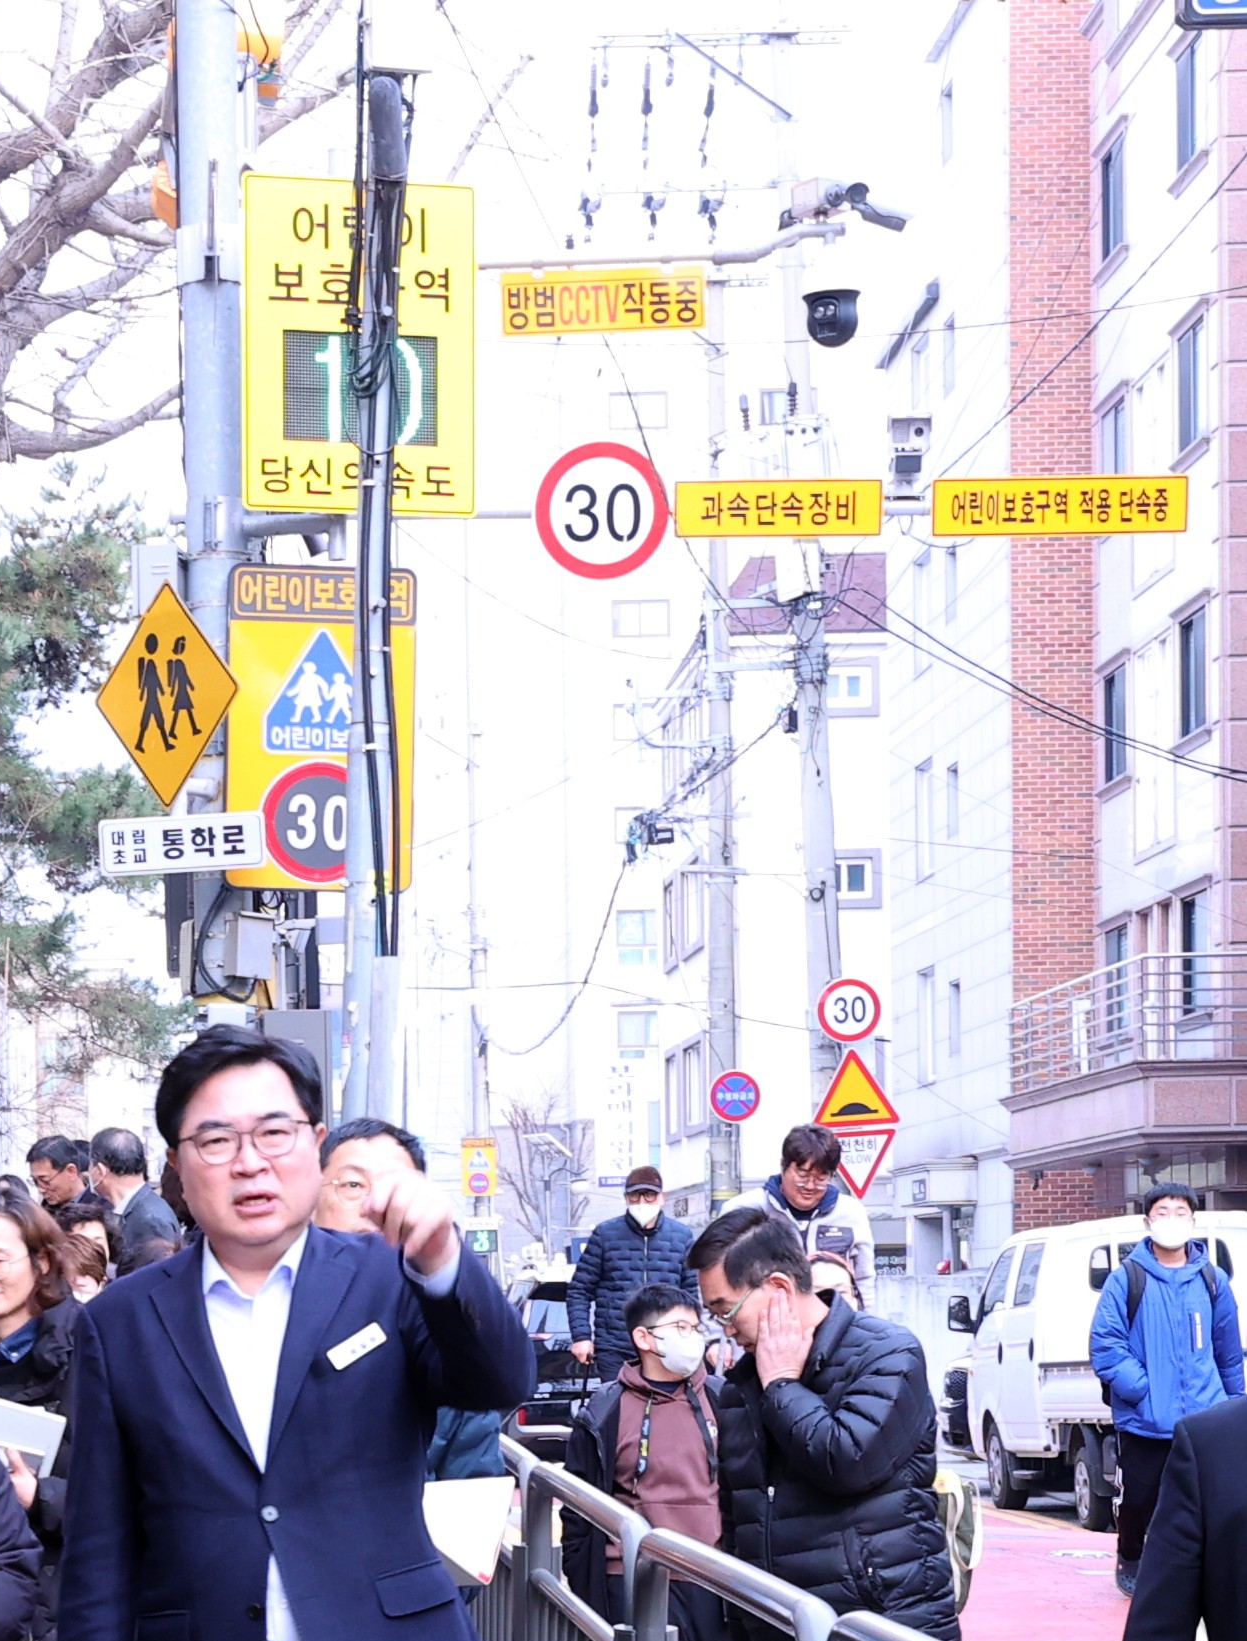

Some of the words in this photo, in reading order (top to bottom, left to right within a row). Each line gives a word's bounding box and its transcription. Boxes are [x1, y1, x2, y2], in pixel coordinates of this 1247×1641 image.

[268, 263, 449, 312] 보호역
[507, 281, 698, 330] 방범CCTV작동중
[564, 483, 641, 543] 30
[700, 490, 857, 527] 과속단속장비
[951, 489, 1069, 526] 어린이보호구역
[1079, 488, 1112, 524] 적용
[1119, 488, 1169, 523] 단속중
[240, 574, 408, 616] 어린이보호역
[111, 829, 145, 846] 대림
[286, 794, 347, 851] 30
[112, 847, 147, 865] 초교
[162, 825, 246, 860] 통학로
[833, 996, 866, 1024] 30
[844, 1154, 872, 1165] SLOW
